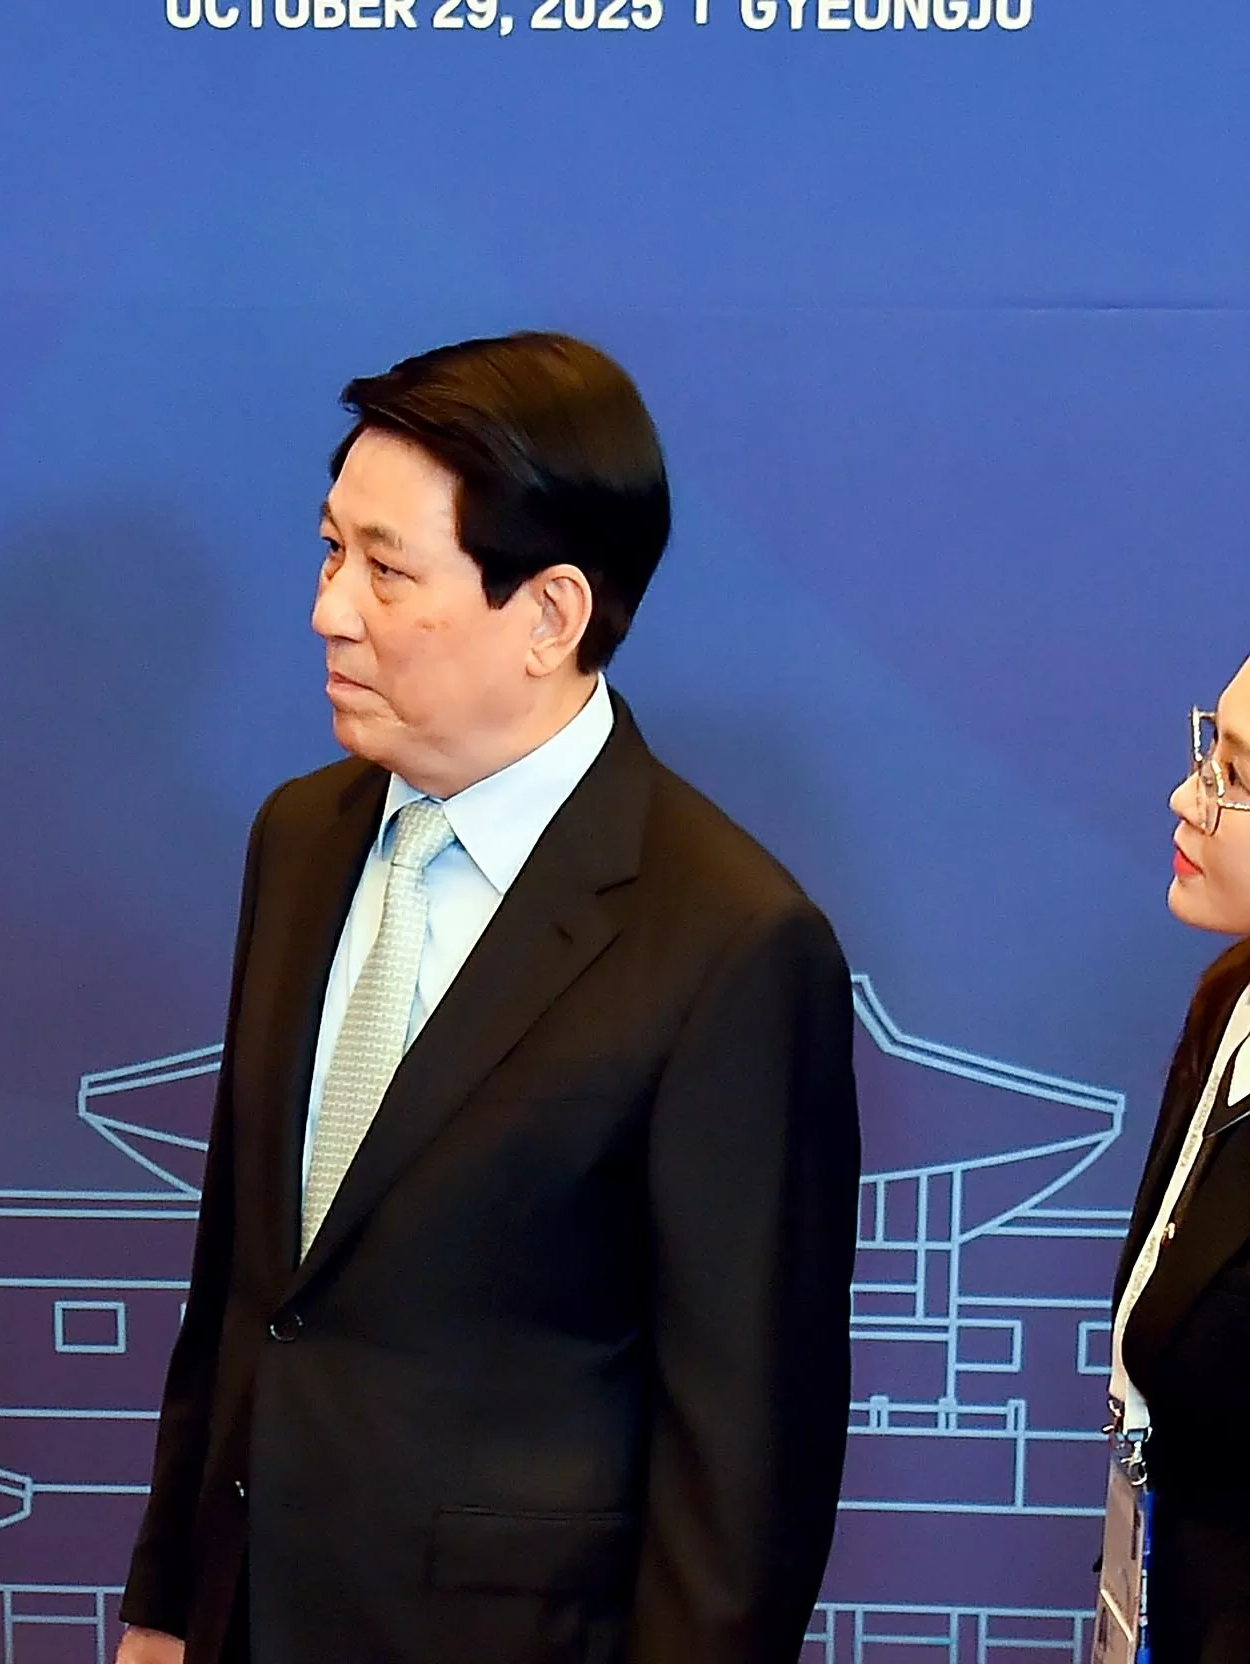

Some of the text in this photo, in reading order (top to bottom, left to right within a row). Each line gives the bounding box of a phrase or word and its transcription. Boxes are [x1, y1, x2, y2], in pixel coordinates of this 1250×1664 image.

[166, 0, 418, 29] OCTOBER
[433, 0, 513, 36] 29,
[530, 0, 663, 30] 2025
[740, 0, 1033, 30] GYEONGJU
